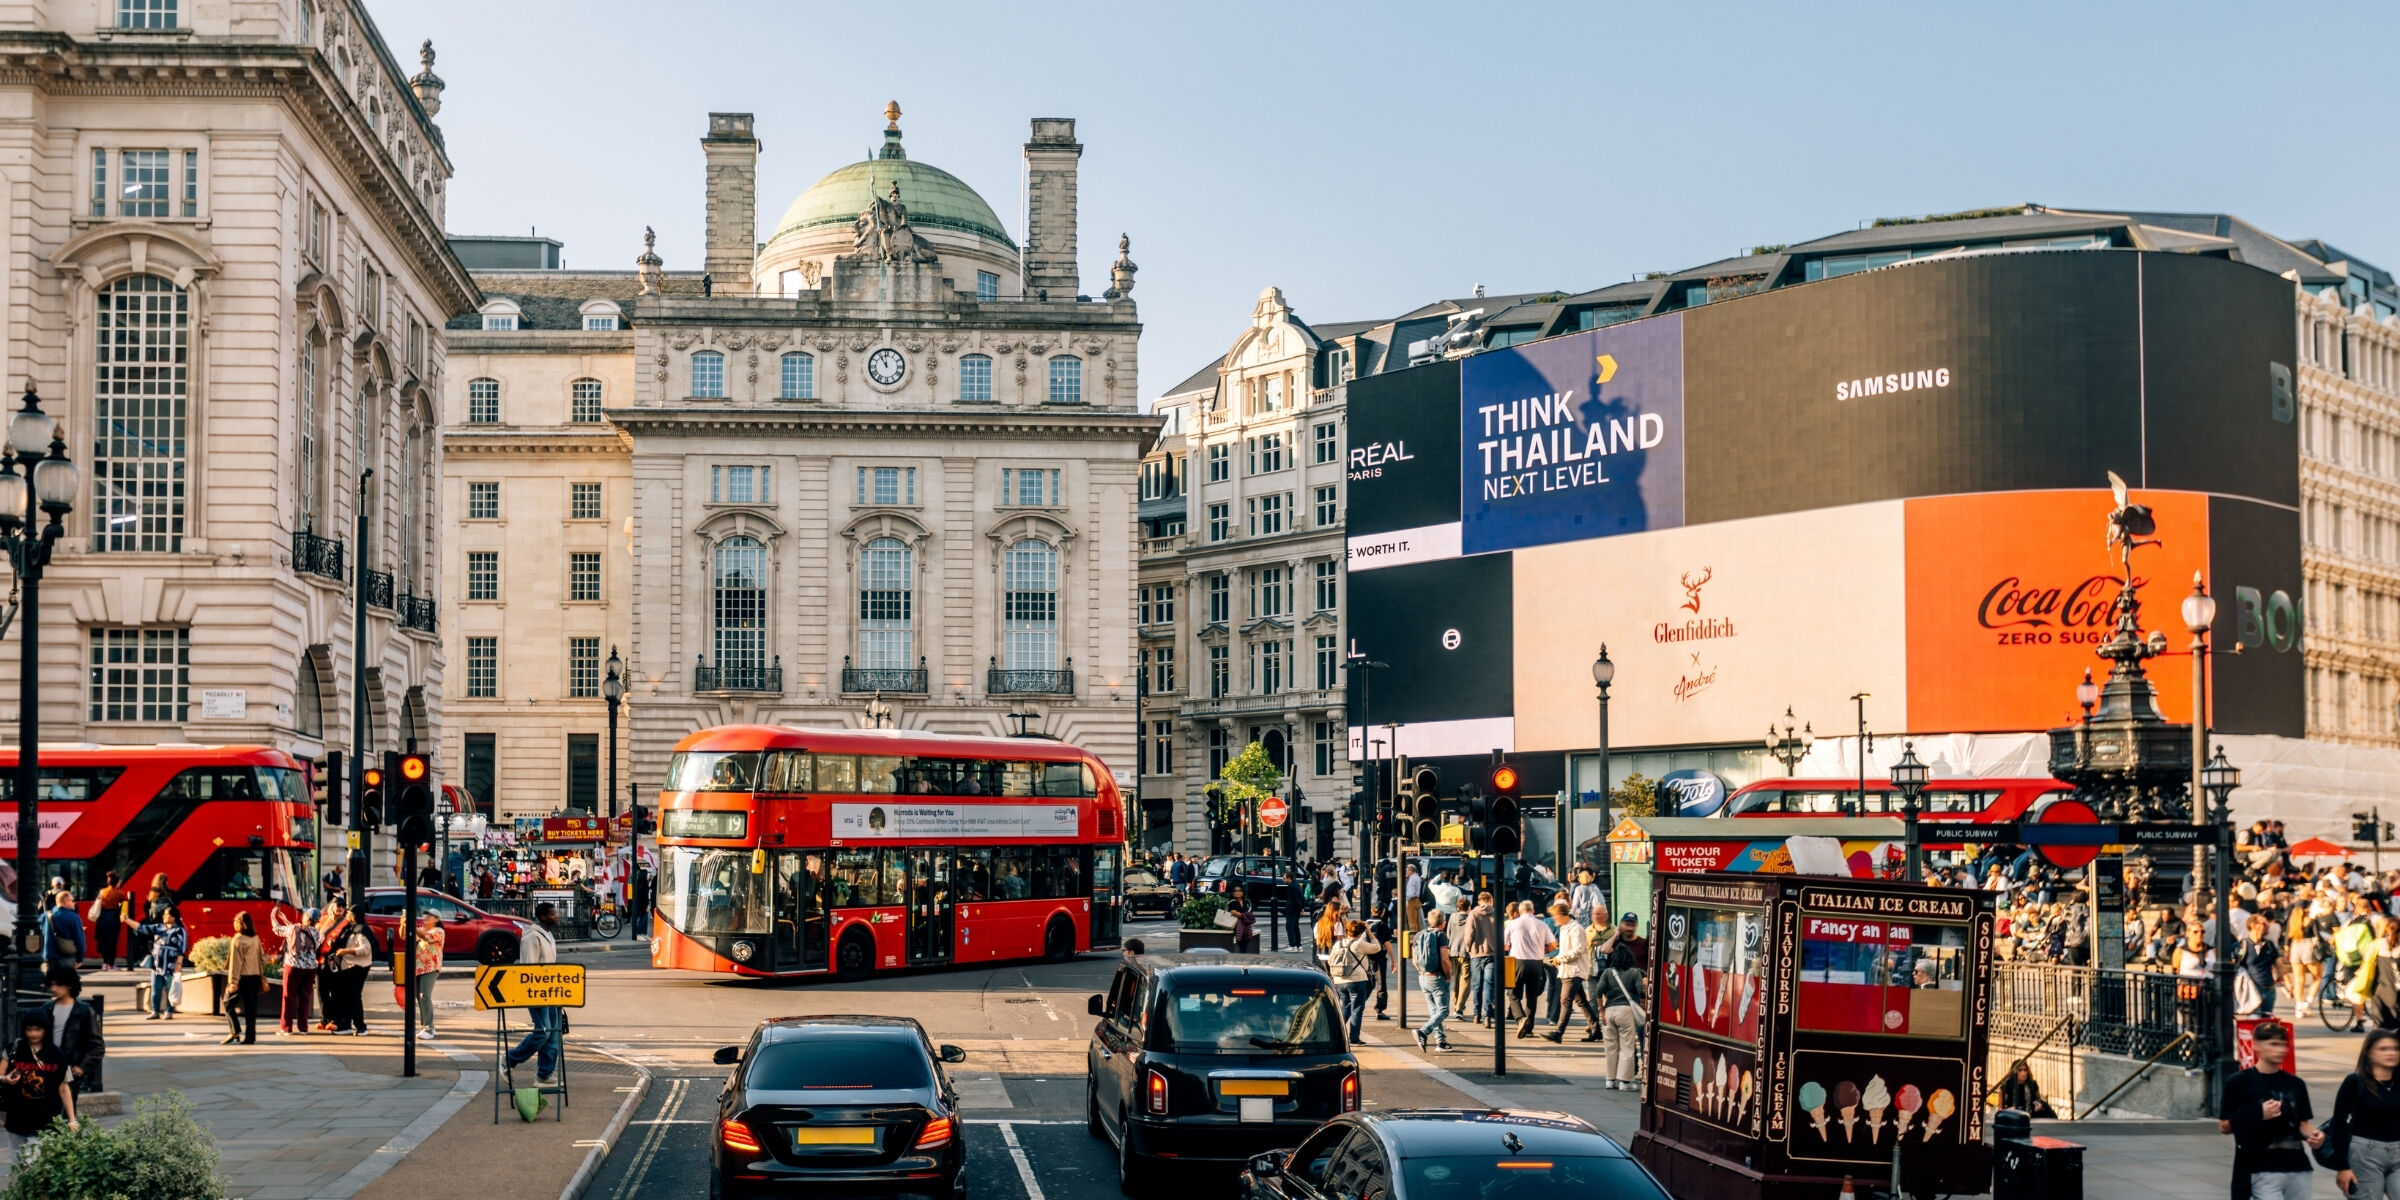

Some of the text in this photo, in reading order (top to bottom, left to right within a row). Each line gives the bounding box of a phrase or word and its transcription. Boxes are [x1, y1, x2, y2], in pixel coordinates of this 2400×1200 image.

[1836, 367, 1950, 401] SAMSUNG
[1479, 390, 1575, 437] THINK
[1348, 440, 1414, 469] RÉAL
[1478, 412, 1664, 475] THAILAND
[1484, 461, 1610, 501] NEXT LEVEL
[1356, 542, 1396, 558] WORTH
[1399, 541, 1410, 552] IT.
[1978, 576, 2062, 629] Coca
[1654, 616, 1734, 644] Glenfiddich
[1998, 632, 2053, 645] ZERO
[1673, 665, 1717, 704] André
[729, 815, 741, 832] 19
[919, 808, 937, 817] Waiting
[1936, 830, 1999, 838] PUBLIC SUBWAY
[2136, 831, 2198, 839] PUBLIC SUBWAY
[1664, 847, 1721, 856] BUY YOUR
[1670, 857, 1716, 867] TICKETS
[1750, 849, 1769, 862] City
[1670, 883, 1763, 901] TRADITIONAL ITALIAN ICE CREAM
[1809, 893, 1964, 915] ITALIAN ICE CREAM
[1810, 919, 1860, 942] Fancy
[1862, 924, 1880, 938] an
[1978, 921, 1990, 979] SOFT
[520, 972, 580, 984] Diverted
[527, 986, 572, 998] traffic
[1976, 983, 1986, 1025] ICE
[1752, 906, 1771, 1132] FLAVOURED ICE CREAM
[1772, 912, 1794, 1130] FLAVOURED ICE CREAM
[1969, 1066, 1982, 1140] CREAM
